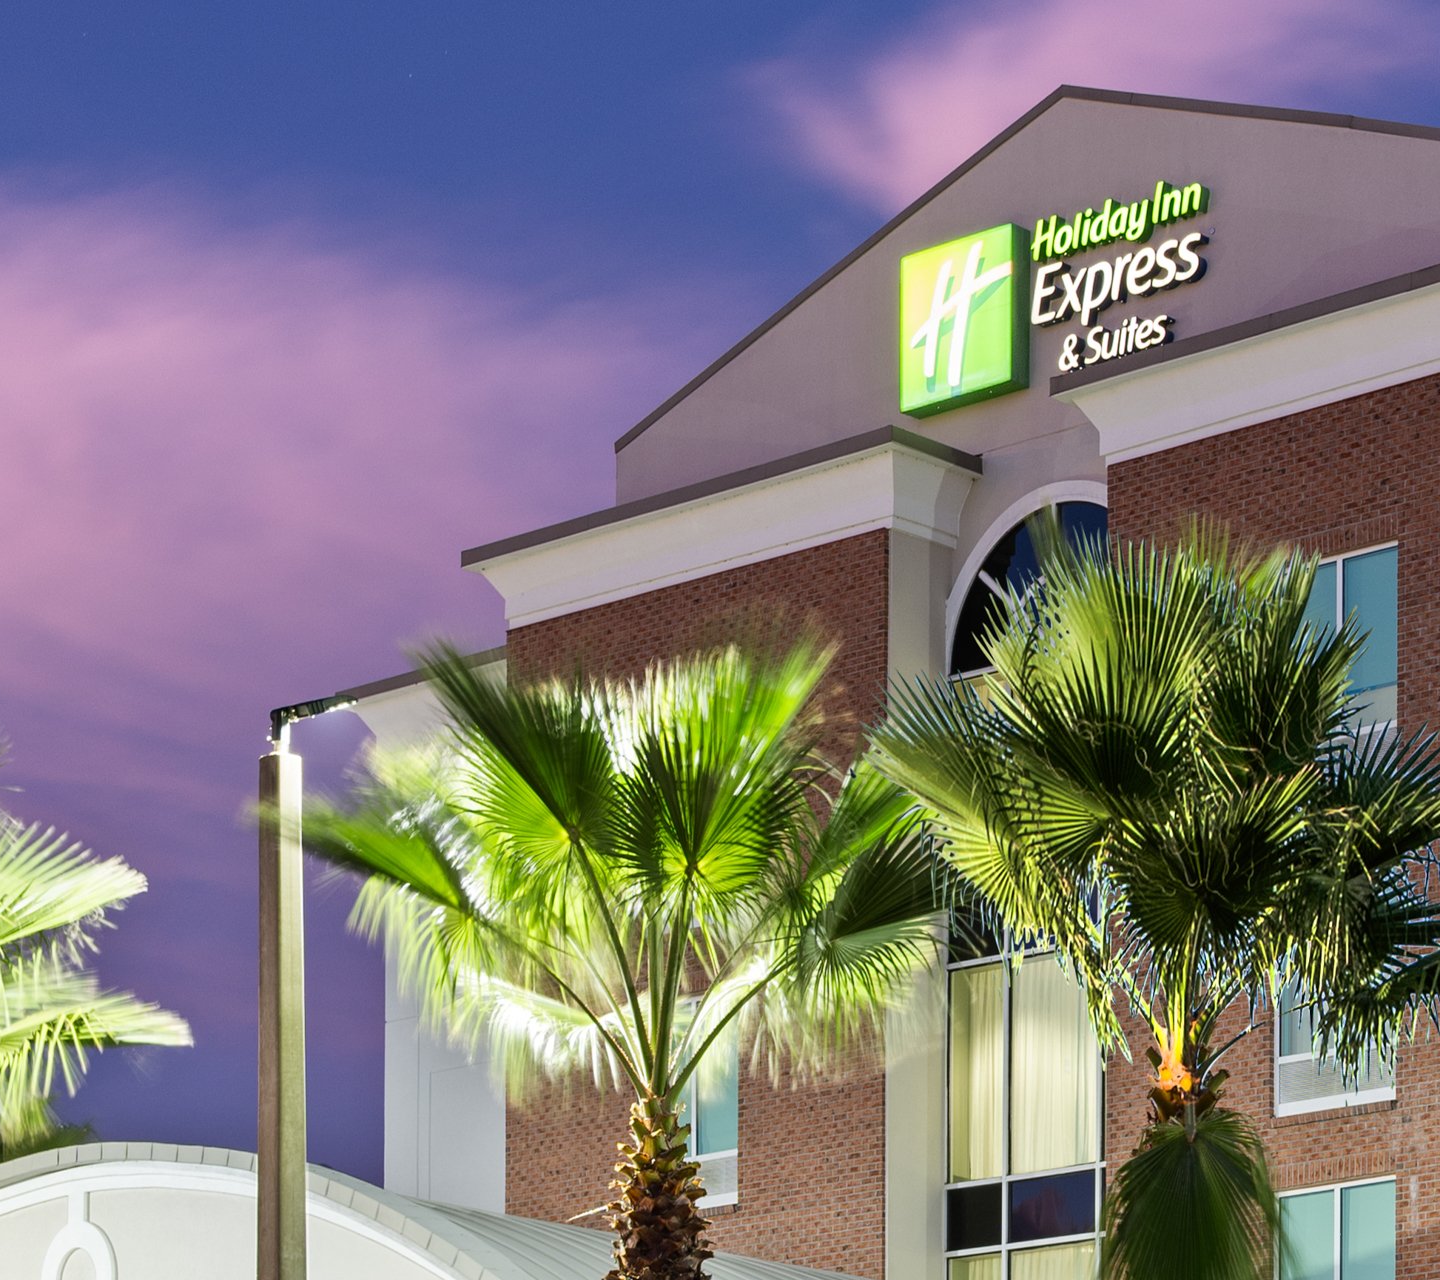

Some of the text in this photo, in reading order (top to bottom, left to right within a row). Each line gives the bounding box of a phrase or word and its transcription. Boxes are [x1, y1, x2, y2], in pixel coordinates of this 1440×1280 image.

[1030, 180, 1202, 261] Holiday Inn
[1031, 232, 1202, 327] Express
[1058, 314, 1168, 372] & Suites
